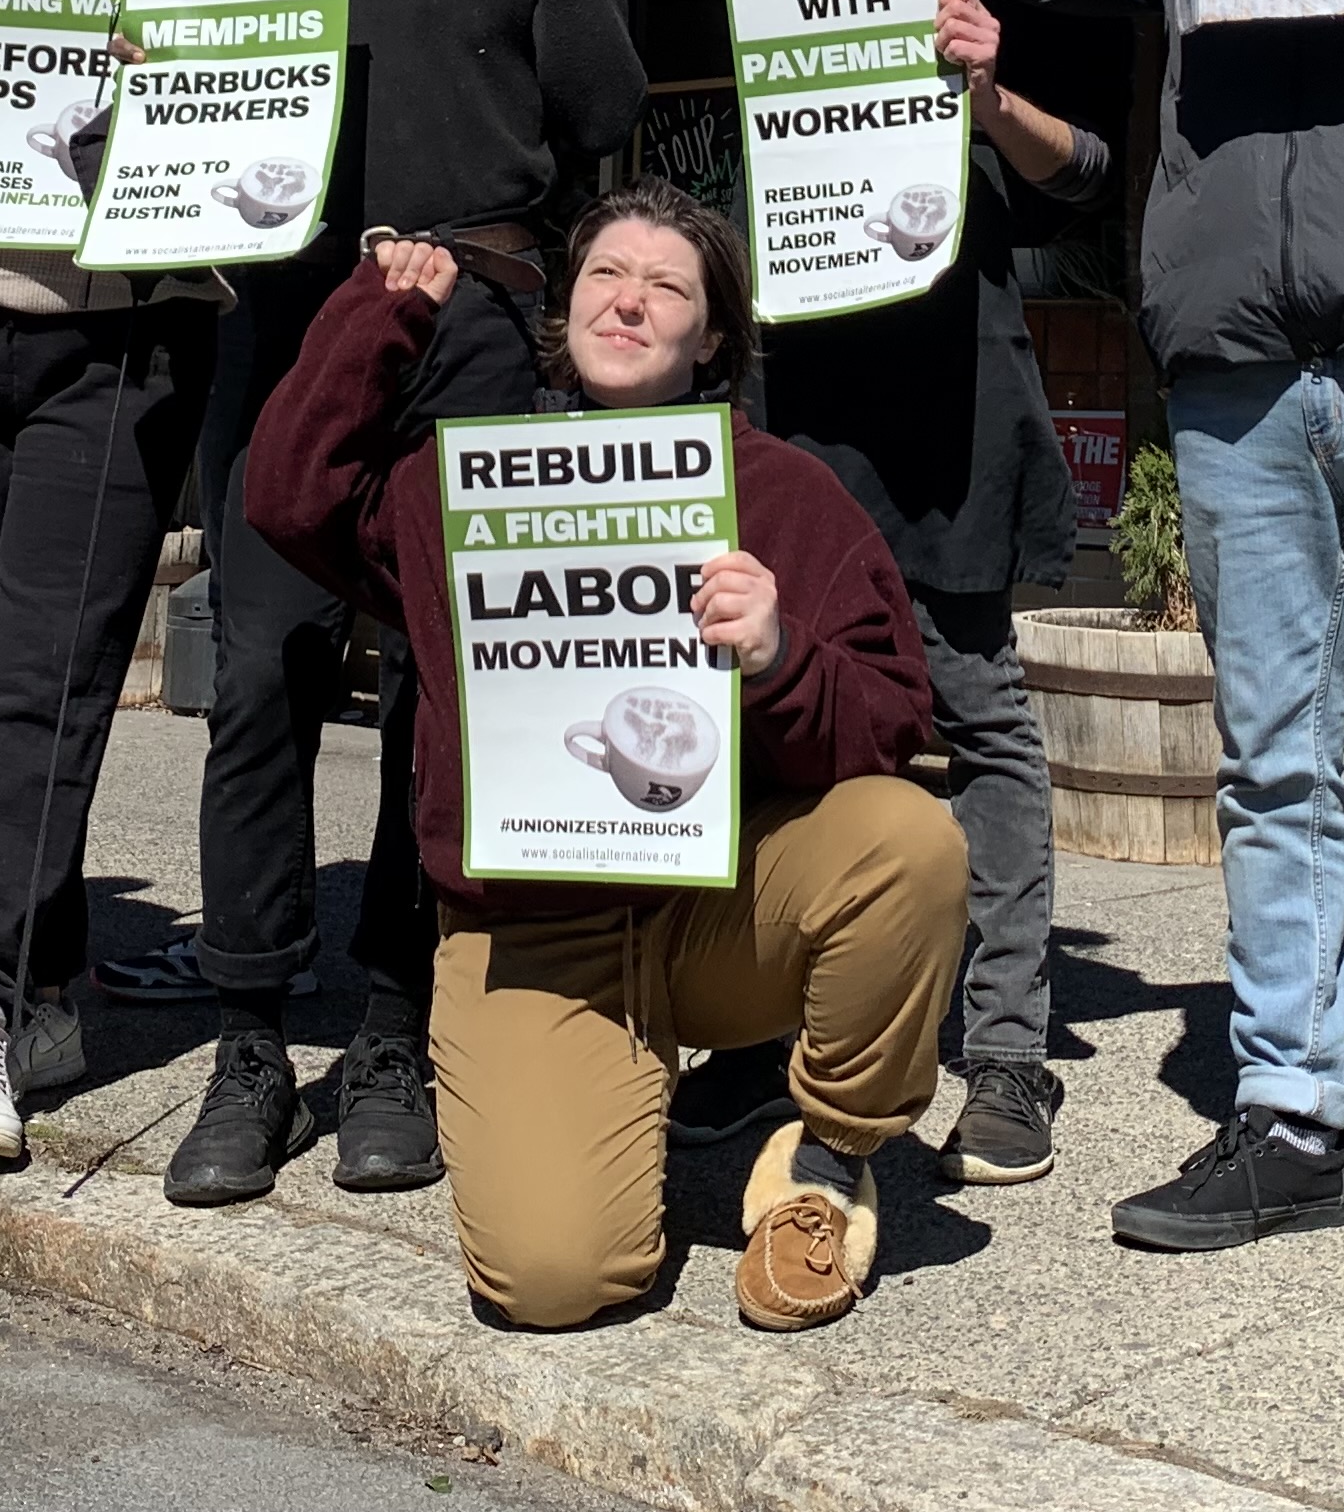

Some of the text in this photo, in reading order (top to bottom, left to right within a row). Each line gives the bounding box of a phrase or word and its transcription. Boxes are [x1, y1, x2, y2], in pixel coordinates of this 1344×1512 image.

[142, 10, 324, 50] MEMPHIS
[742, 33, 938, 84] PAVEMEN
[128, 63, 331, 96] STARBUCKS
[144, 95, 310, 126] WORKERS
[754, 92, 959, 141] WORKERS
[658, 114, 717, 184] SOUP
[117, 159, 230, 179] SAY NO TO
[112, 184, 181, 200] UNION
[765, 178, 874, 205] REBUILD A
[105, 204, 202, 220] BUSTING
[766, 204, 864, 228] FIGHTING
[125, 241, 263, 256] www.socialistalternative.org
[767, 232, 836, 252] LABOR
[769, 248, 882, 276] MOVEMENT
[799, 275, 915, 305] www.socialistalternative.org
[459, 439, 712, 489] REBUILD
[1072, 435, 1121, 465] THE
[463, 503, 715, 546] A FIGHTING
[499, 817, 703, 838] #UNIONIZESTARBUCKS
[521, 846, 681, 866] www.socialistalternative.org
